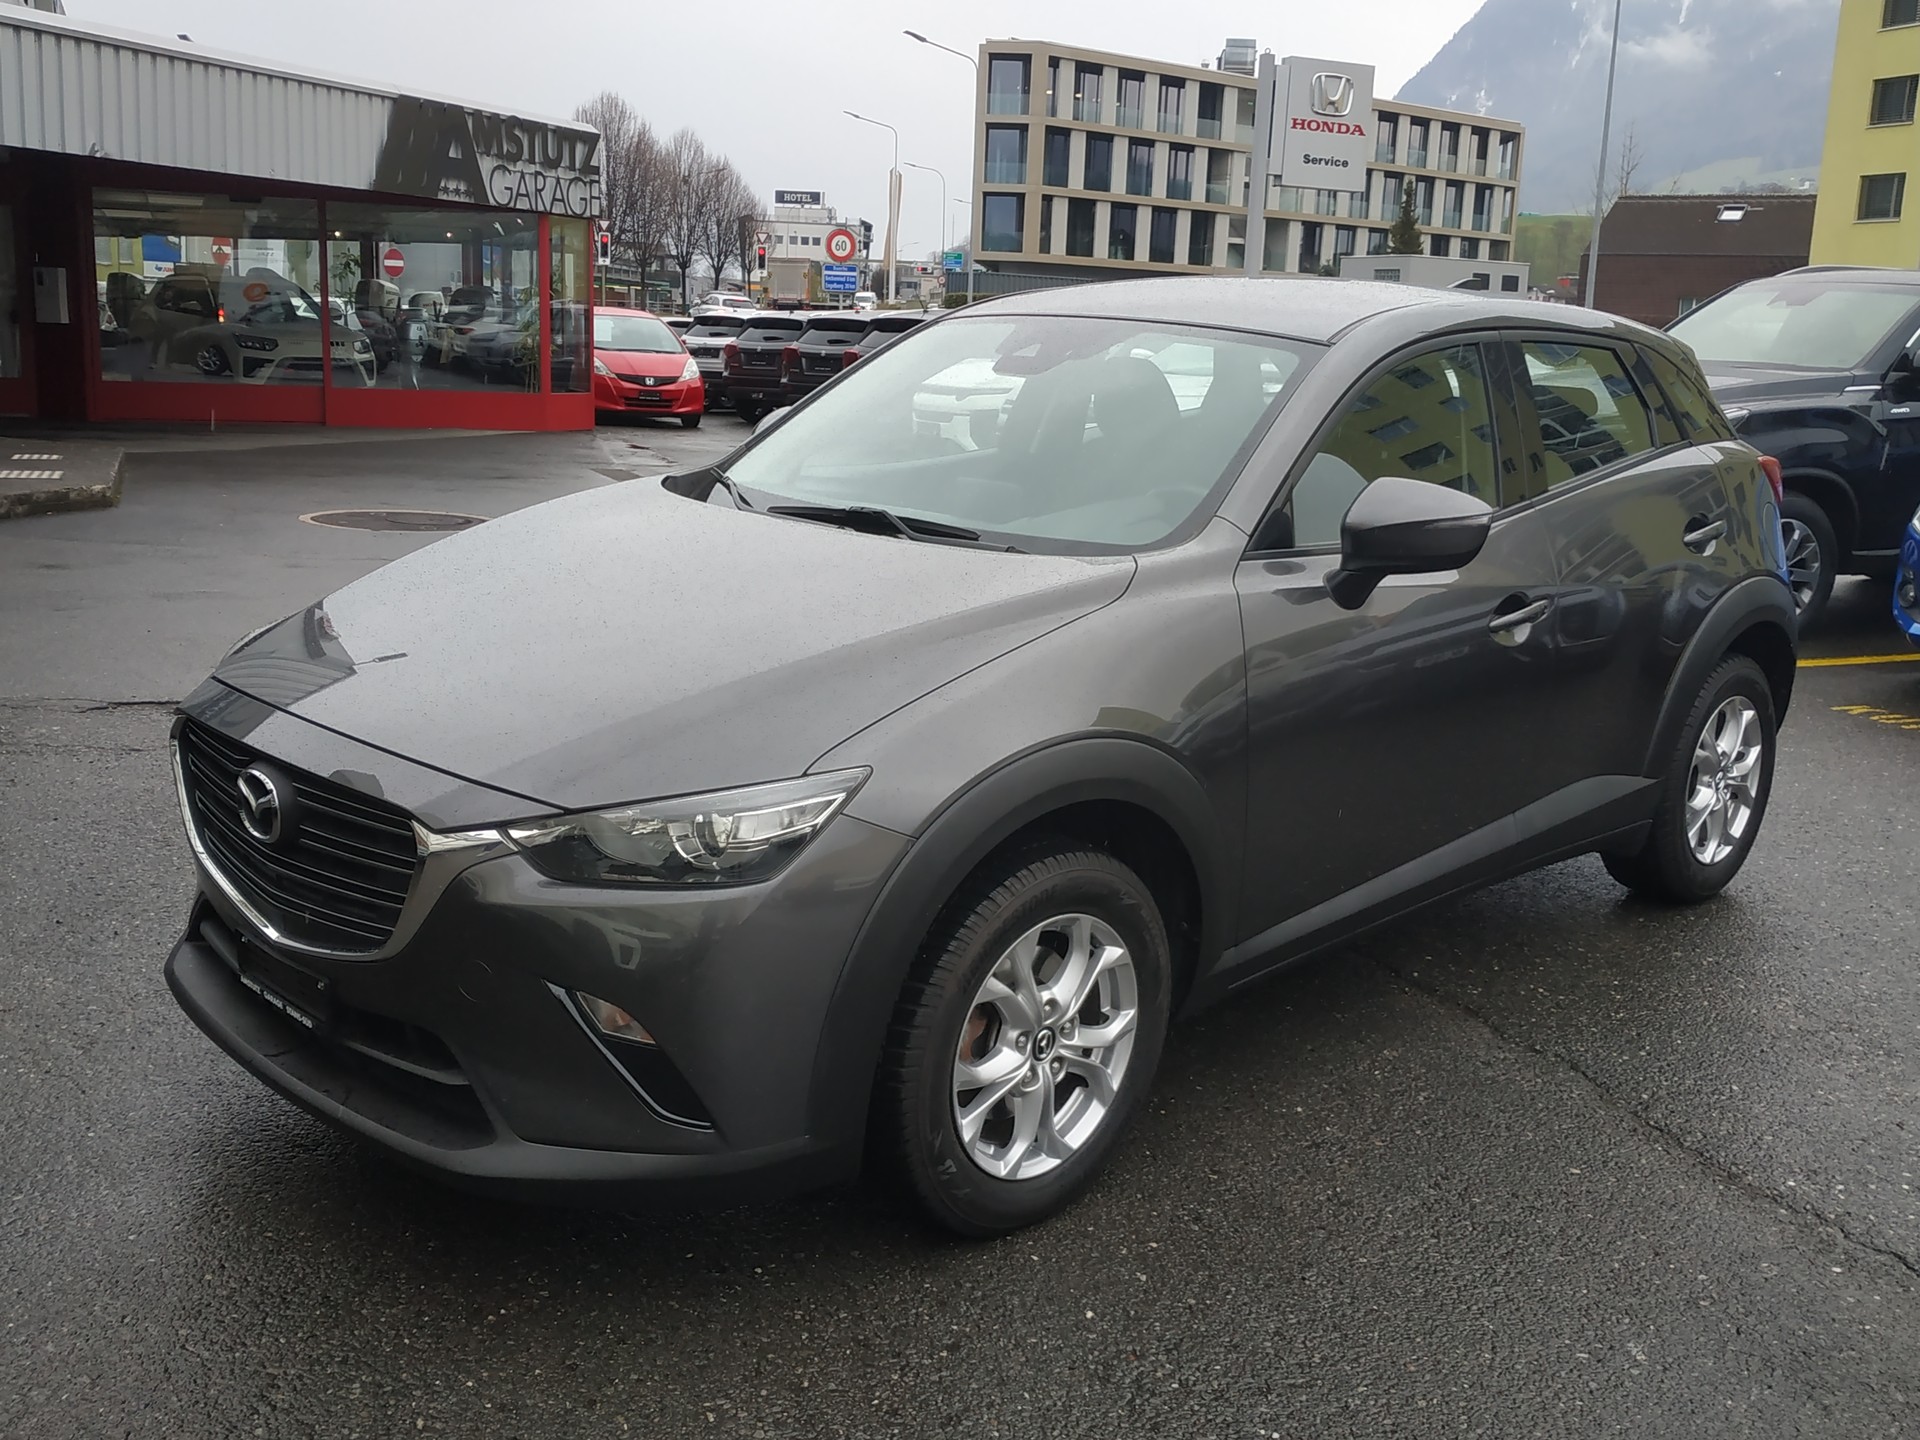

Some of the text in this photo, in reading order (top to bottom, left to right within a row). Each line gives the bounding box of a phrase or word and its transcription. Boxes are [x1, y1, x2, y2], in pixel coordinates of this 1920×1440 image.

[1290, 117, 1366, 137] HONDA
[1302, 153, 1349, 168] Service
[489, 164, 601, 218] GARAGE
[783, 193, 813, 203] HOTEL
[835, 240, 847, 251] 60
